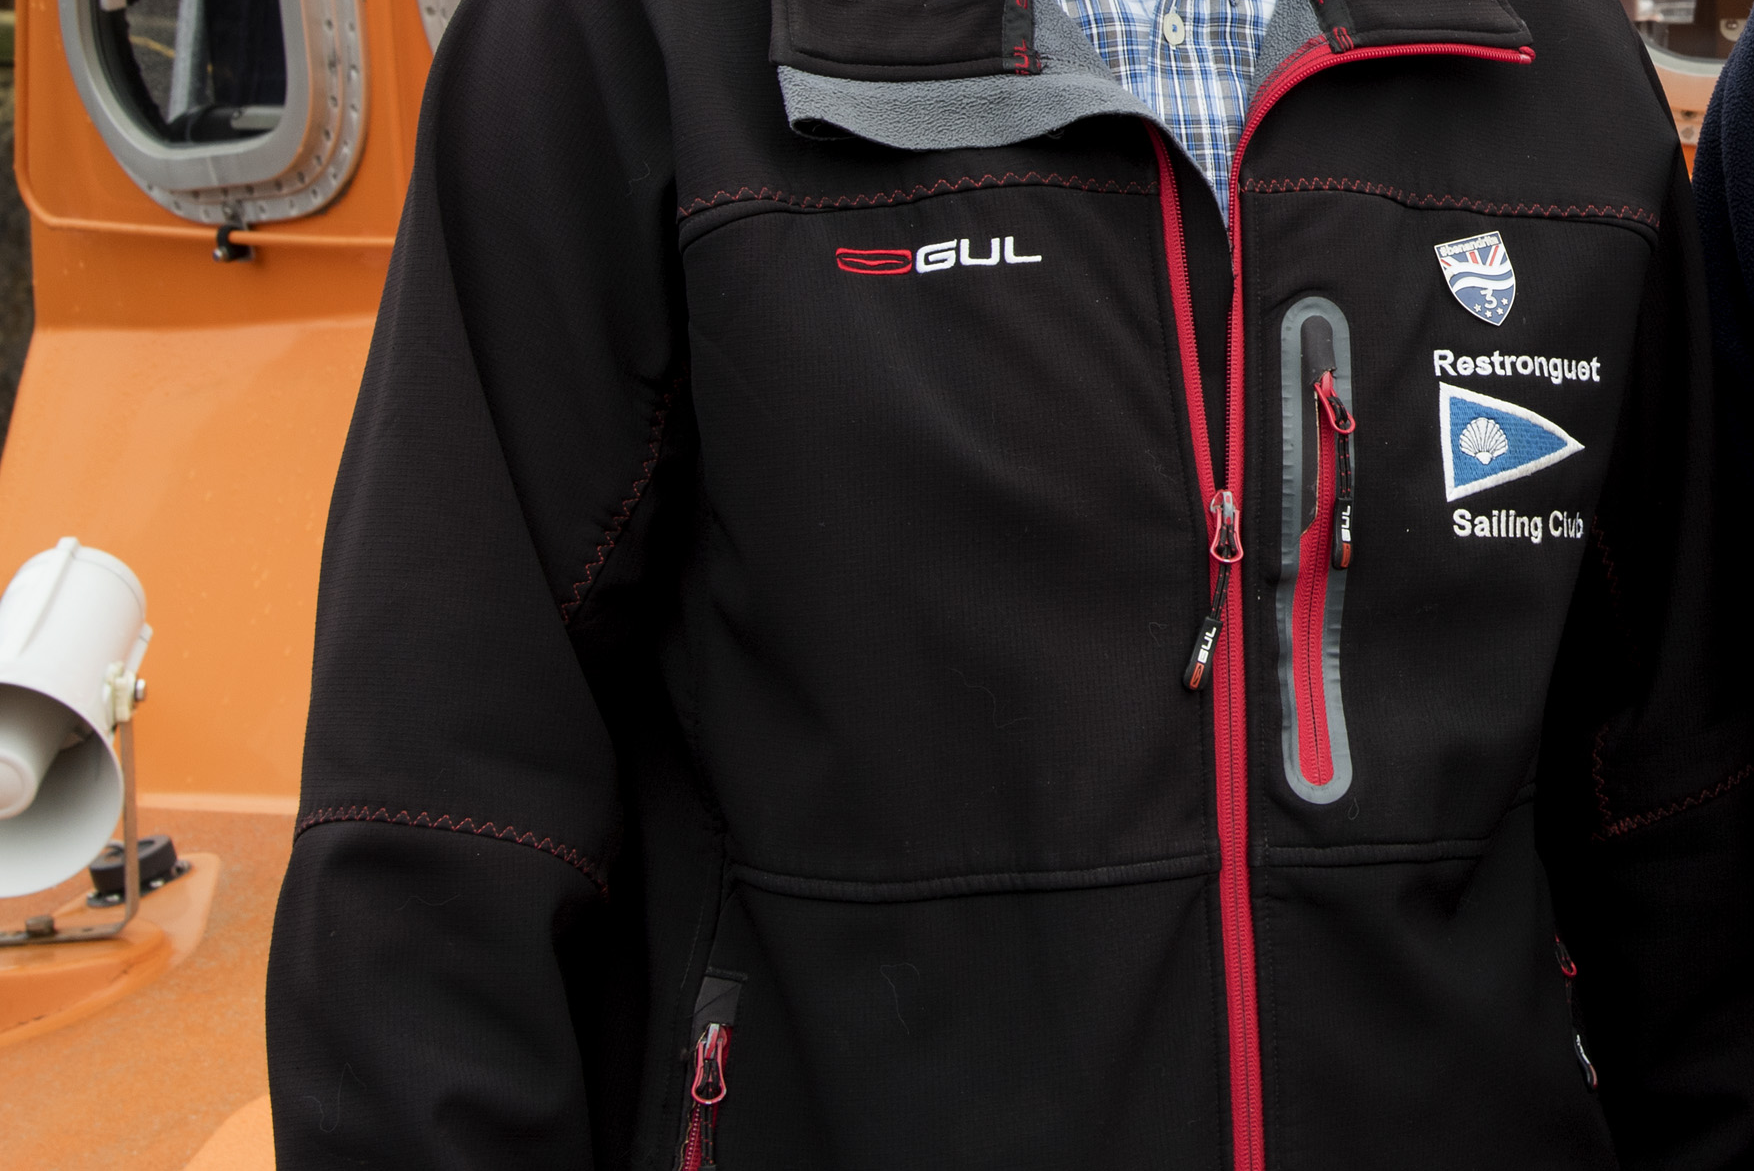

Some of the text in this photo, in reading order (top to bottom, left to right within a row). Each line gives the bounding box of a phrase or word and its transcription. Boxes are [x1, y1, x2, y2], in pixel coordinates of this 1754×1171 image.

[915, 235, 1042, 274] GUL
[1480, 289, 1497, 309] 3
[1433, 349, 1601, 384] Restronguet
[1452, 508, 1584, 544] Sailing Club
